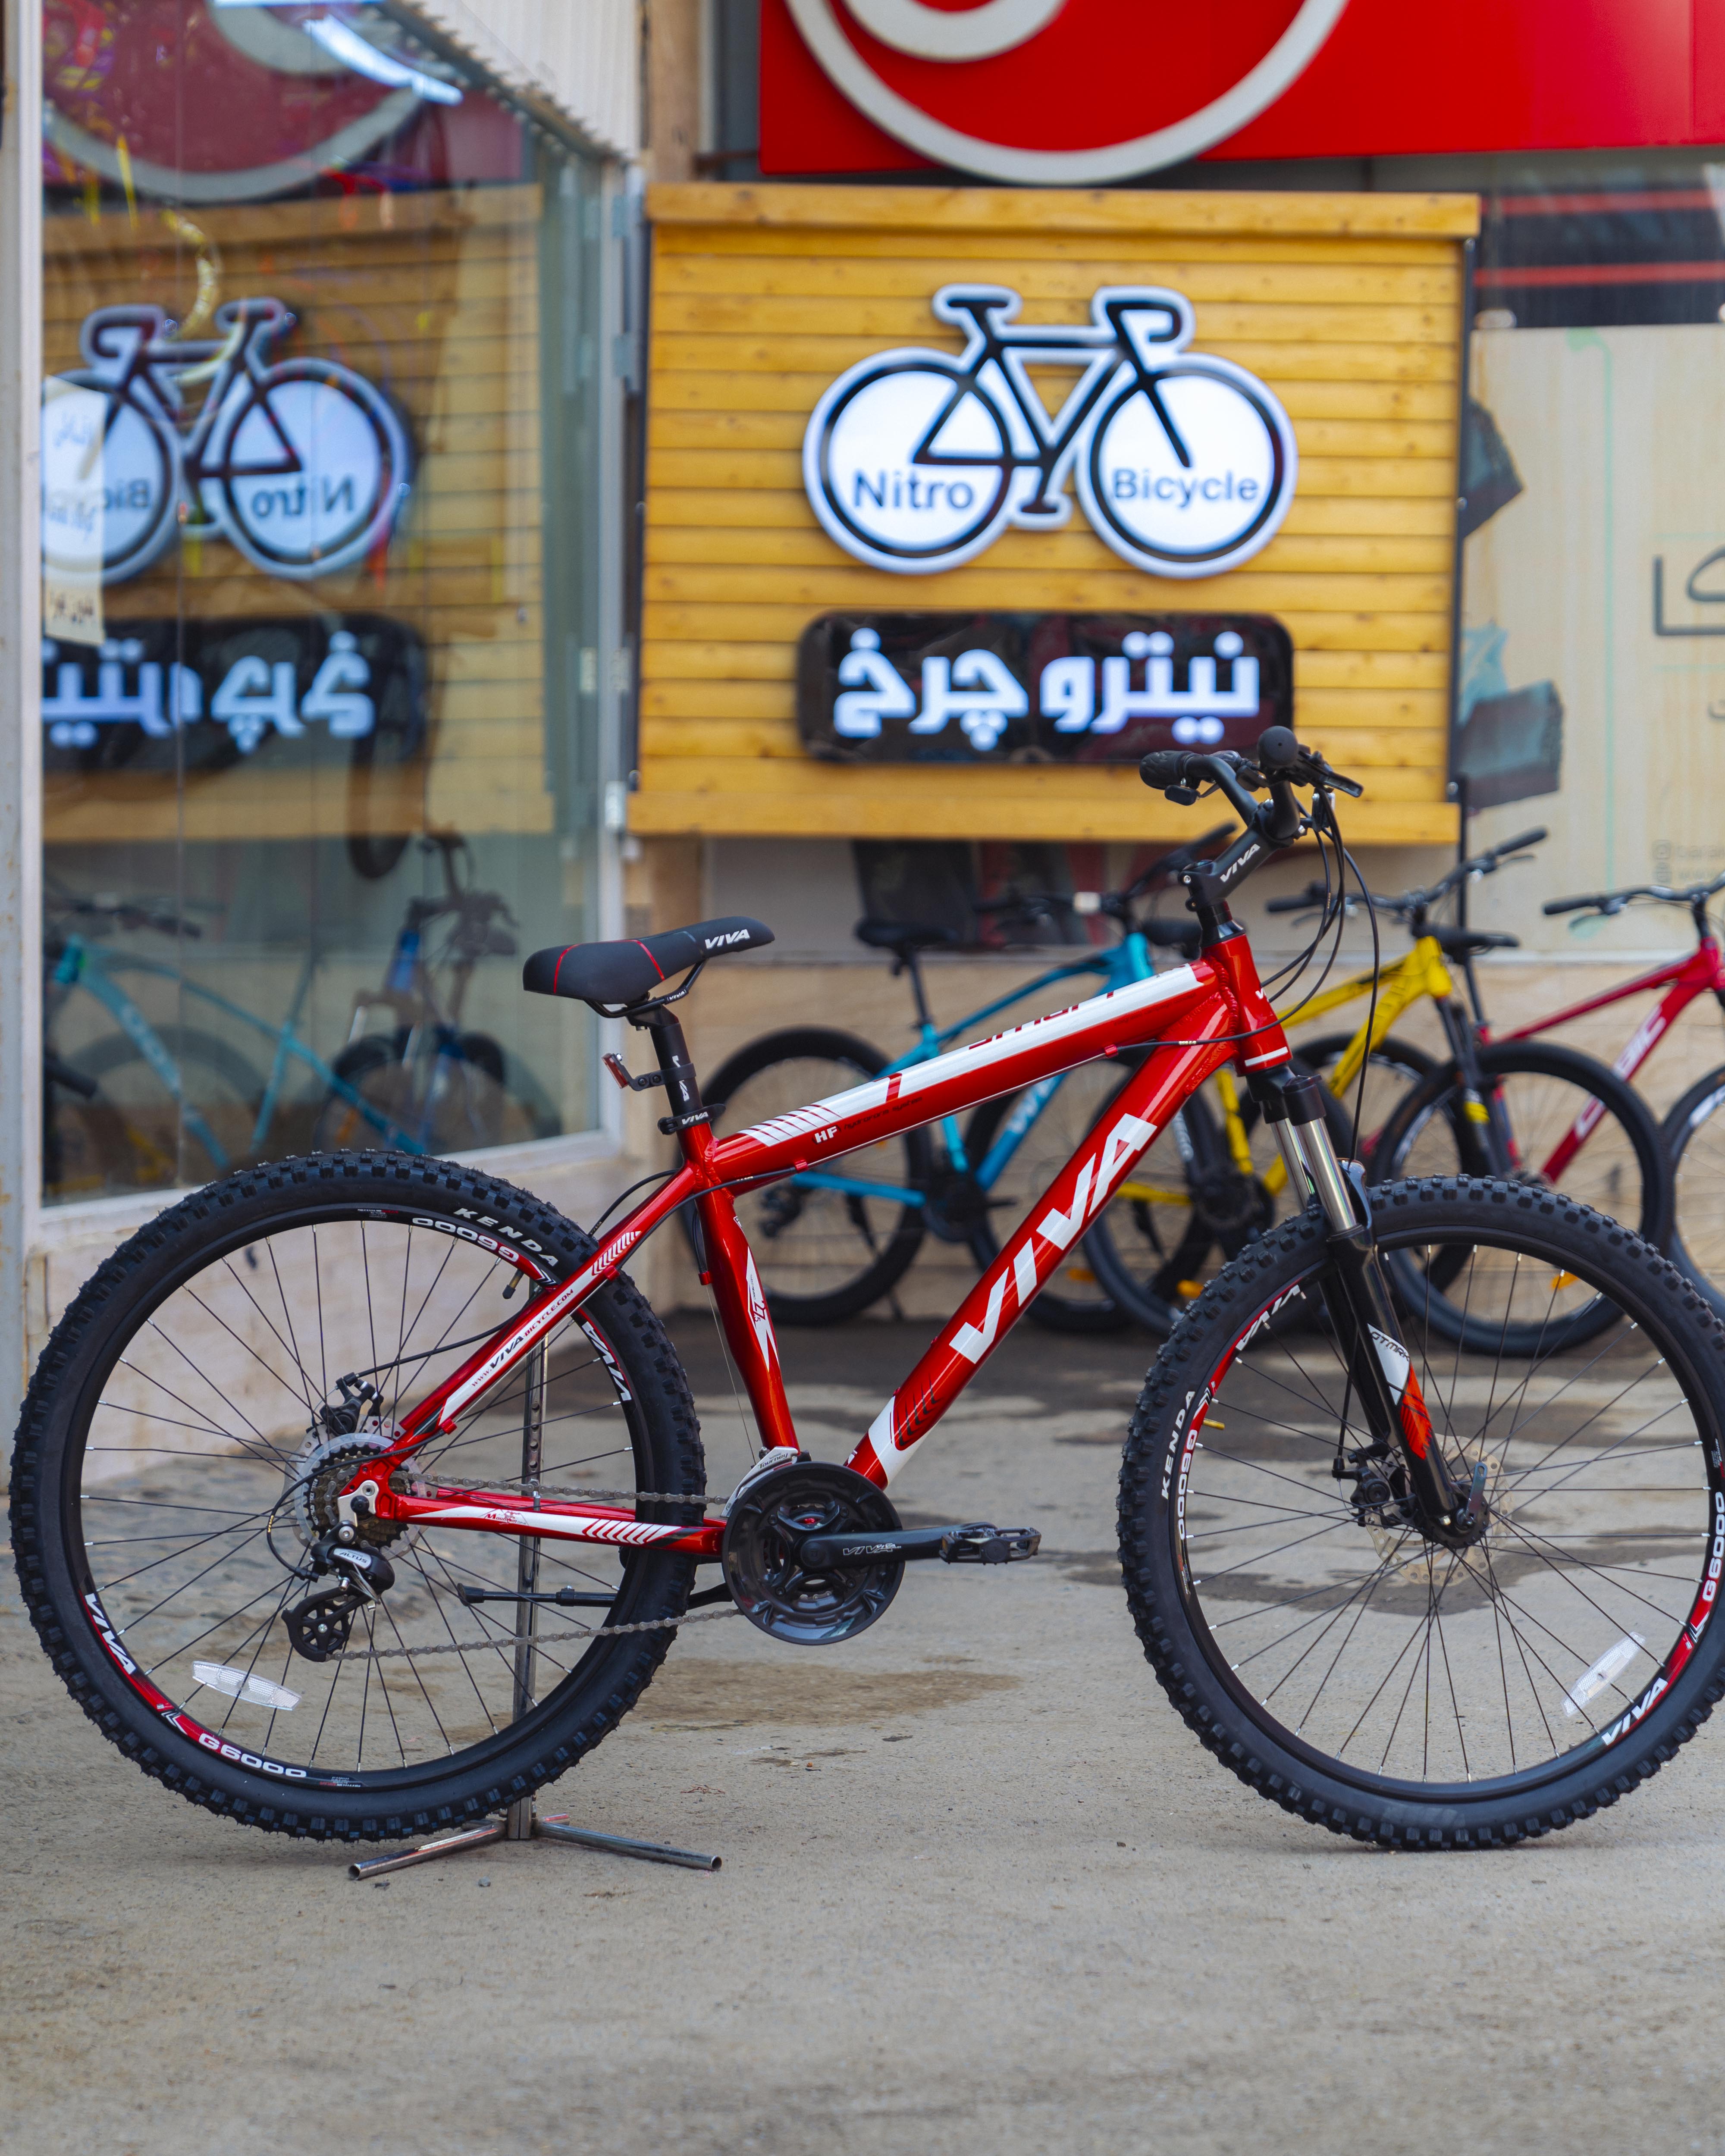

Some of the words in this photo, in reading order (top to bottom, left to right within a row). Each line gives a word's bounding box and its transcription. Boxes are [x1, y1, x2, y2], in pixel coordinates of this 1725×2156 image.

[851, 469, 975, 511] Nitro
[1112, 467, 1259, 511] Bicycle
[832, 627, 1030, 752] چرخ
[1039, 630, 1261, 745] نیترو
[1220, 843, 1261, 883] VIVA
[705, 928, 750, 949] VIVA
[671, 1055, 689, 1101] VVA
[681, 1110, 709, 1125] VIVA
[814, 1125, 838, 1143] HF
[412, 1217, 519, 1262] G6000
[453, 1207, 559, 1267] KENDA
[949, 1112, 1157, 1364] VIVA
[1235, 1285, 1300, 1351] VIVA
[581, 1321, 632, 1401] VIVA
[759, 1453, 788, 1469] Tourney
[1161, 1390, 1195, 1500] KENDA
[1178, 1429, 1198, 1540] G6000
[339, 1552, 368, 1564] ALTUS
[843, 1545, 893, 1555] VIVA
[1702, 1491, 1725, 1601] G6000
[85, 1593, 136, 1675] VIVA
[1601, 1677, 1668, 1745] VIVA
[198, 1733, 307, 1778] G6000
